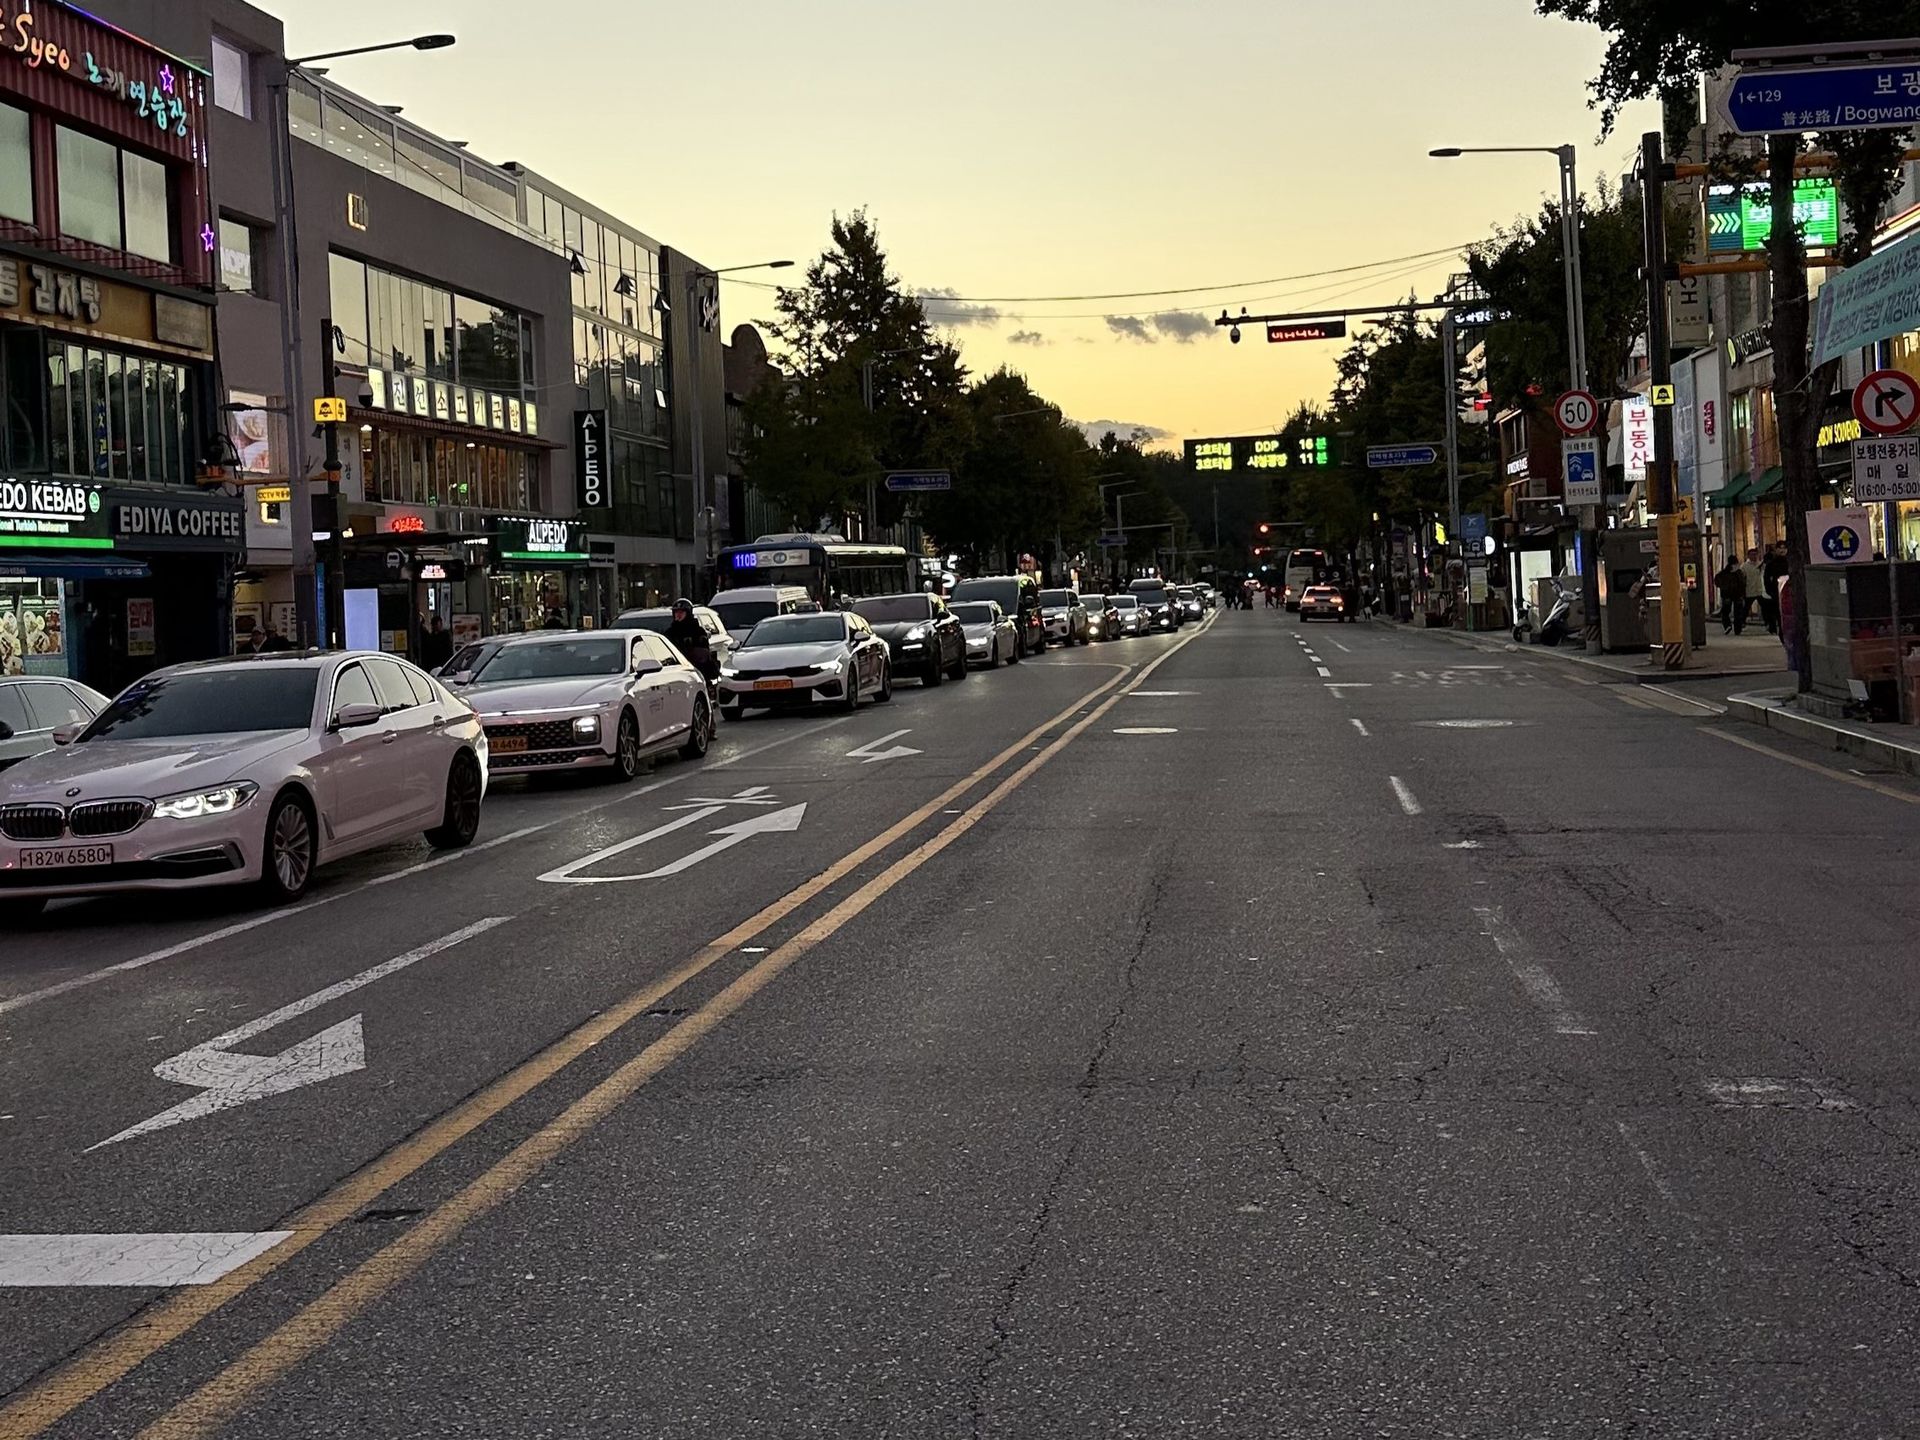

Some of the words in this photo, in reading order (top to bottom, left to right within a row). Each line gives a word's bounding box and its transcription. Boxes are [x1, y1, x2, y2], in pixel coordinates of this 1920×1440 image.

[14, 13, 70, 70] Syeo
[1565, 401, 1587, 424] 50
[1254, 440, 1279, 453] DDP
[1629, 408, 1650, 470] 부동산
[1856, 443, 1918, 460] 보행전용거리
[582, 413, 600, 505] ALPEDO
[31, 484, 86, 514] KEBAB
[120, 505, 173, 535] EDIYA
[177, 508, 240, 537] COFFEE
[528, 522, 568, 544] ALPEDO
[735, 553, 757, 568] 110B
